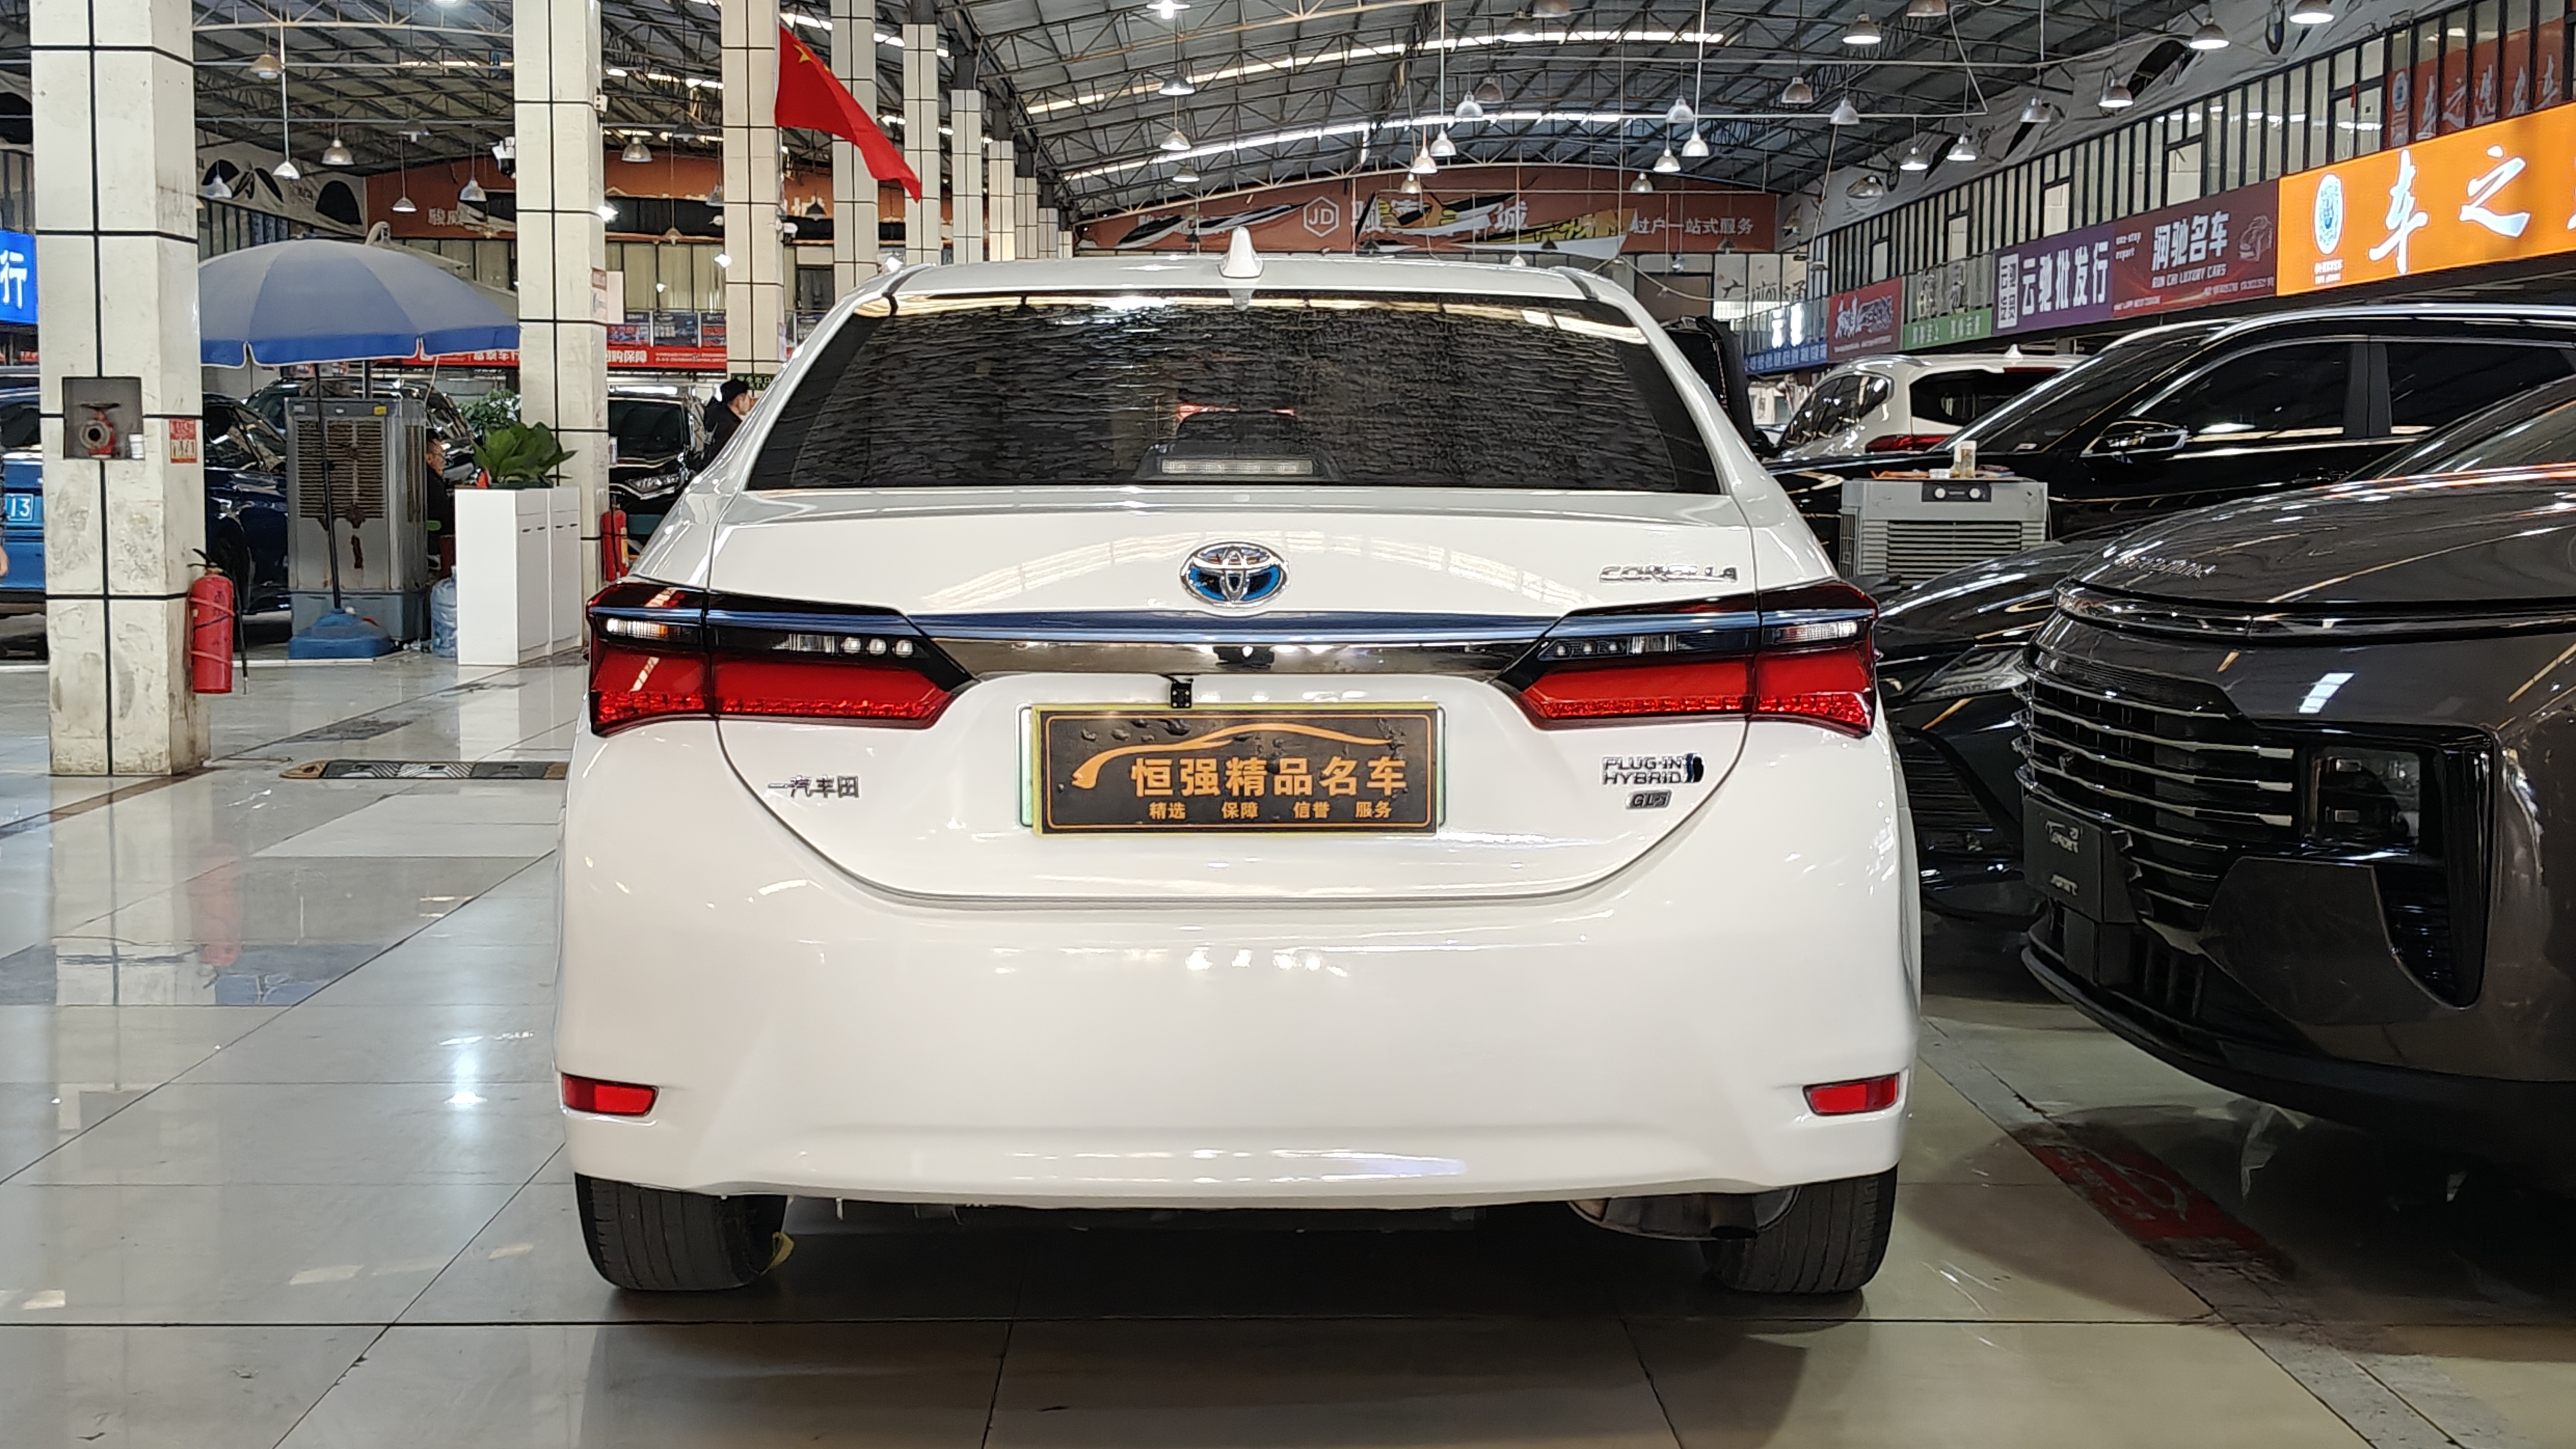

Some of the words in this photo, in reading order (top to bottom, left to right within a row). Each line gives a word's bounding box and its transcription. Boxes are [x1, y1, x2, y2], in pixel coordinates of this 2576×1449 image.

[1308, 208, 1335, 226] JD
[2368, 145, 2576, 275] 车之
[1634, 216, 1754, 235] 过户一站式服务
[2151, 211, 2229, 272] 润驰名车
[0, 250, 27, 309] 行
[2021, 241, 2109, 316] 云驰批发行
[1603, 755, 1683, 770] PLUG-IN
[767, 774, 859, 799] 一汽丰田
[1130, 755, 1408, 799] 恒强精品名车
[1603, 771, 1682, 785] HYBRID
[1148, 801, 1187, 819] 精选
[1221, 801, 1259, 819] 保障
[1293, 801, 1331, 819] 信誉
[1355, 801, 1393, 818] 服务
